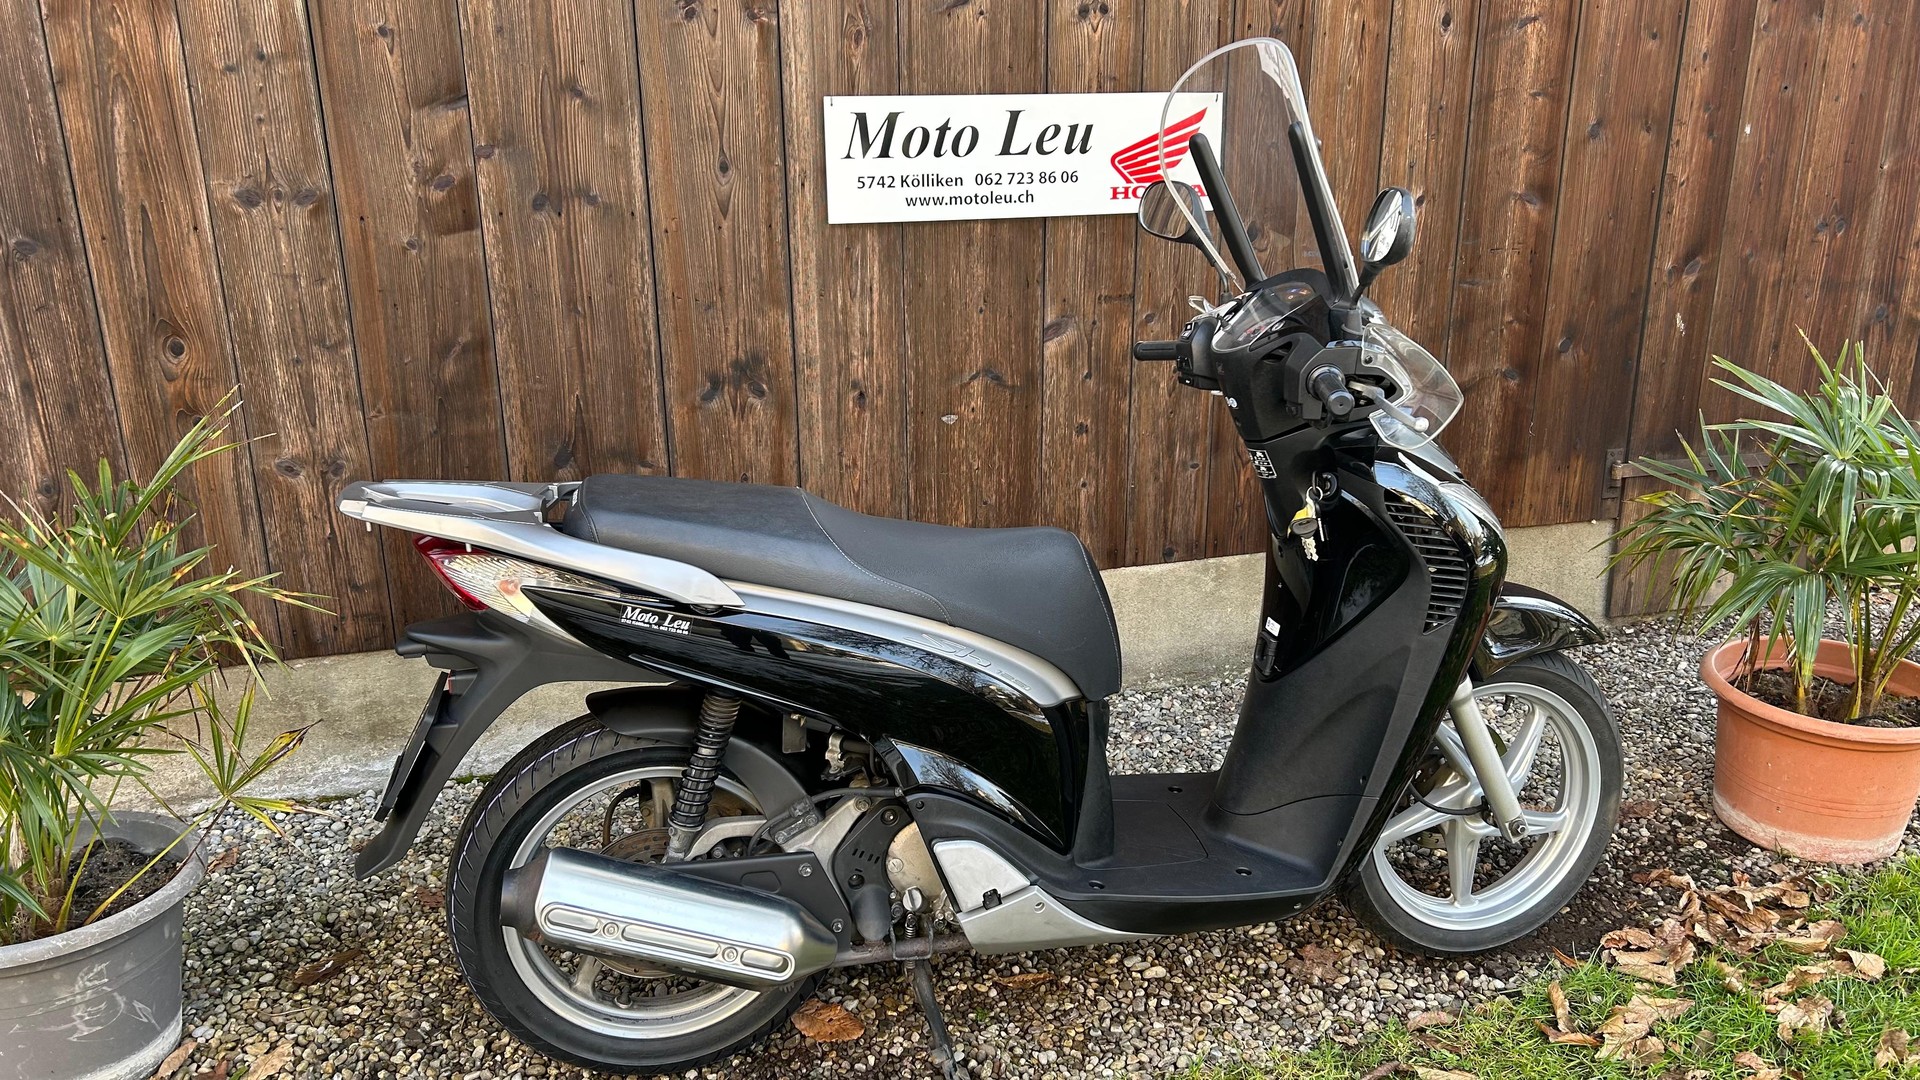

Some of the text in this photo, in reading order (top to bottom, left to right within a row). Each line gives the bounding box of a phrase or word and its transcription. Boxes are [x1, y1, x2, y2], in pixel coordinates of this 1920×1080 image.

[841, 109, 1094, 160] Moto Leu
[857, 170, 1079, 190] 5742 Kölliken 062 723 86 06
[905, 189, 1034, 207] www.motoleu.ch
[1110, 184, 1208, 200] HOA
[622, 605, 659, 624] Moto
[663, 613, 691, 630] Leu
